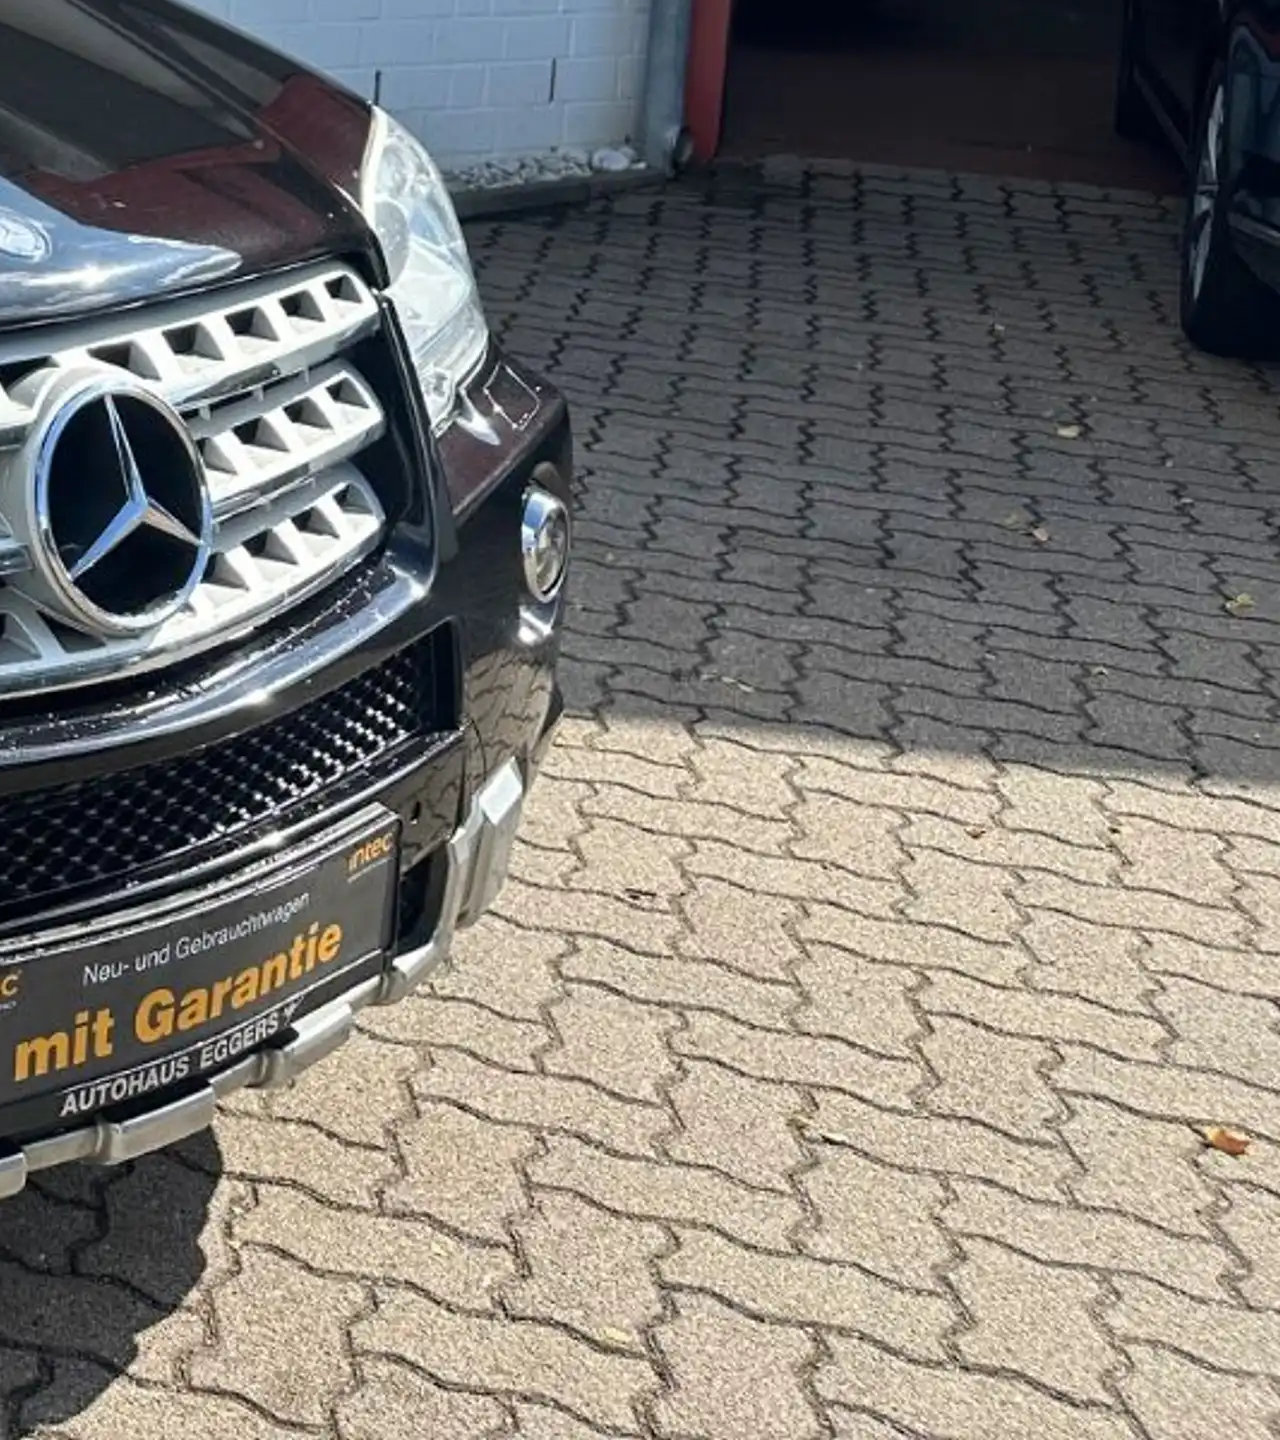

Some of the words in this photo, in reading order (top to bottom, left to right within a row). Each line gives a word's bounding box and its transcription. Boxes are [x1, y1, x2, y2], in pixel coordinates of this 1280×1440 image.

[347, 831, 393, 872] intec
[82, 962, 130, 986] Neu-
[135, 944, 171, 972] und
[176, 892, 311, 959] Gebrauchtwagen
[14, 1007, 115, 1082] mit
[135, 921, 343, 1044] Garantie
[60, 1055, 190, 1117] AUTOHAUS
[200, 1011, 279, 1070] EGGERS
